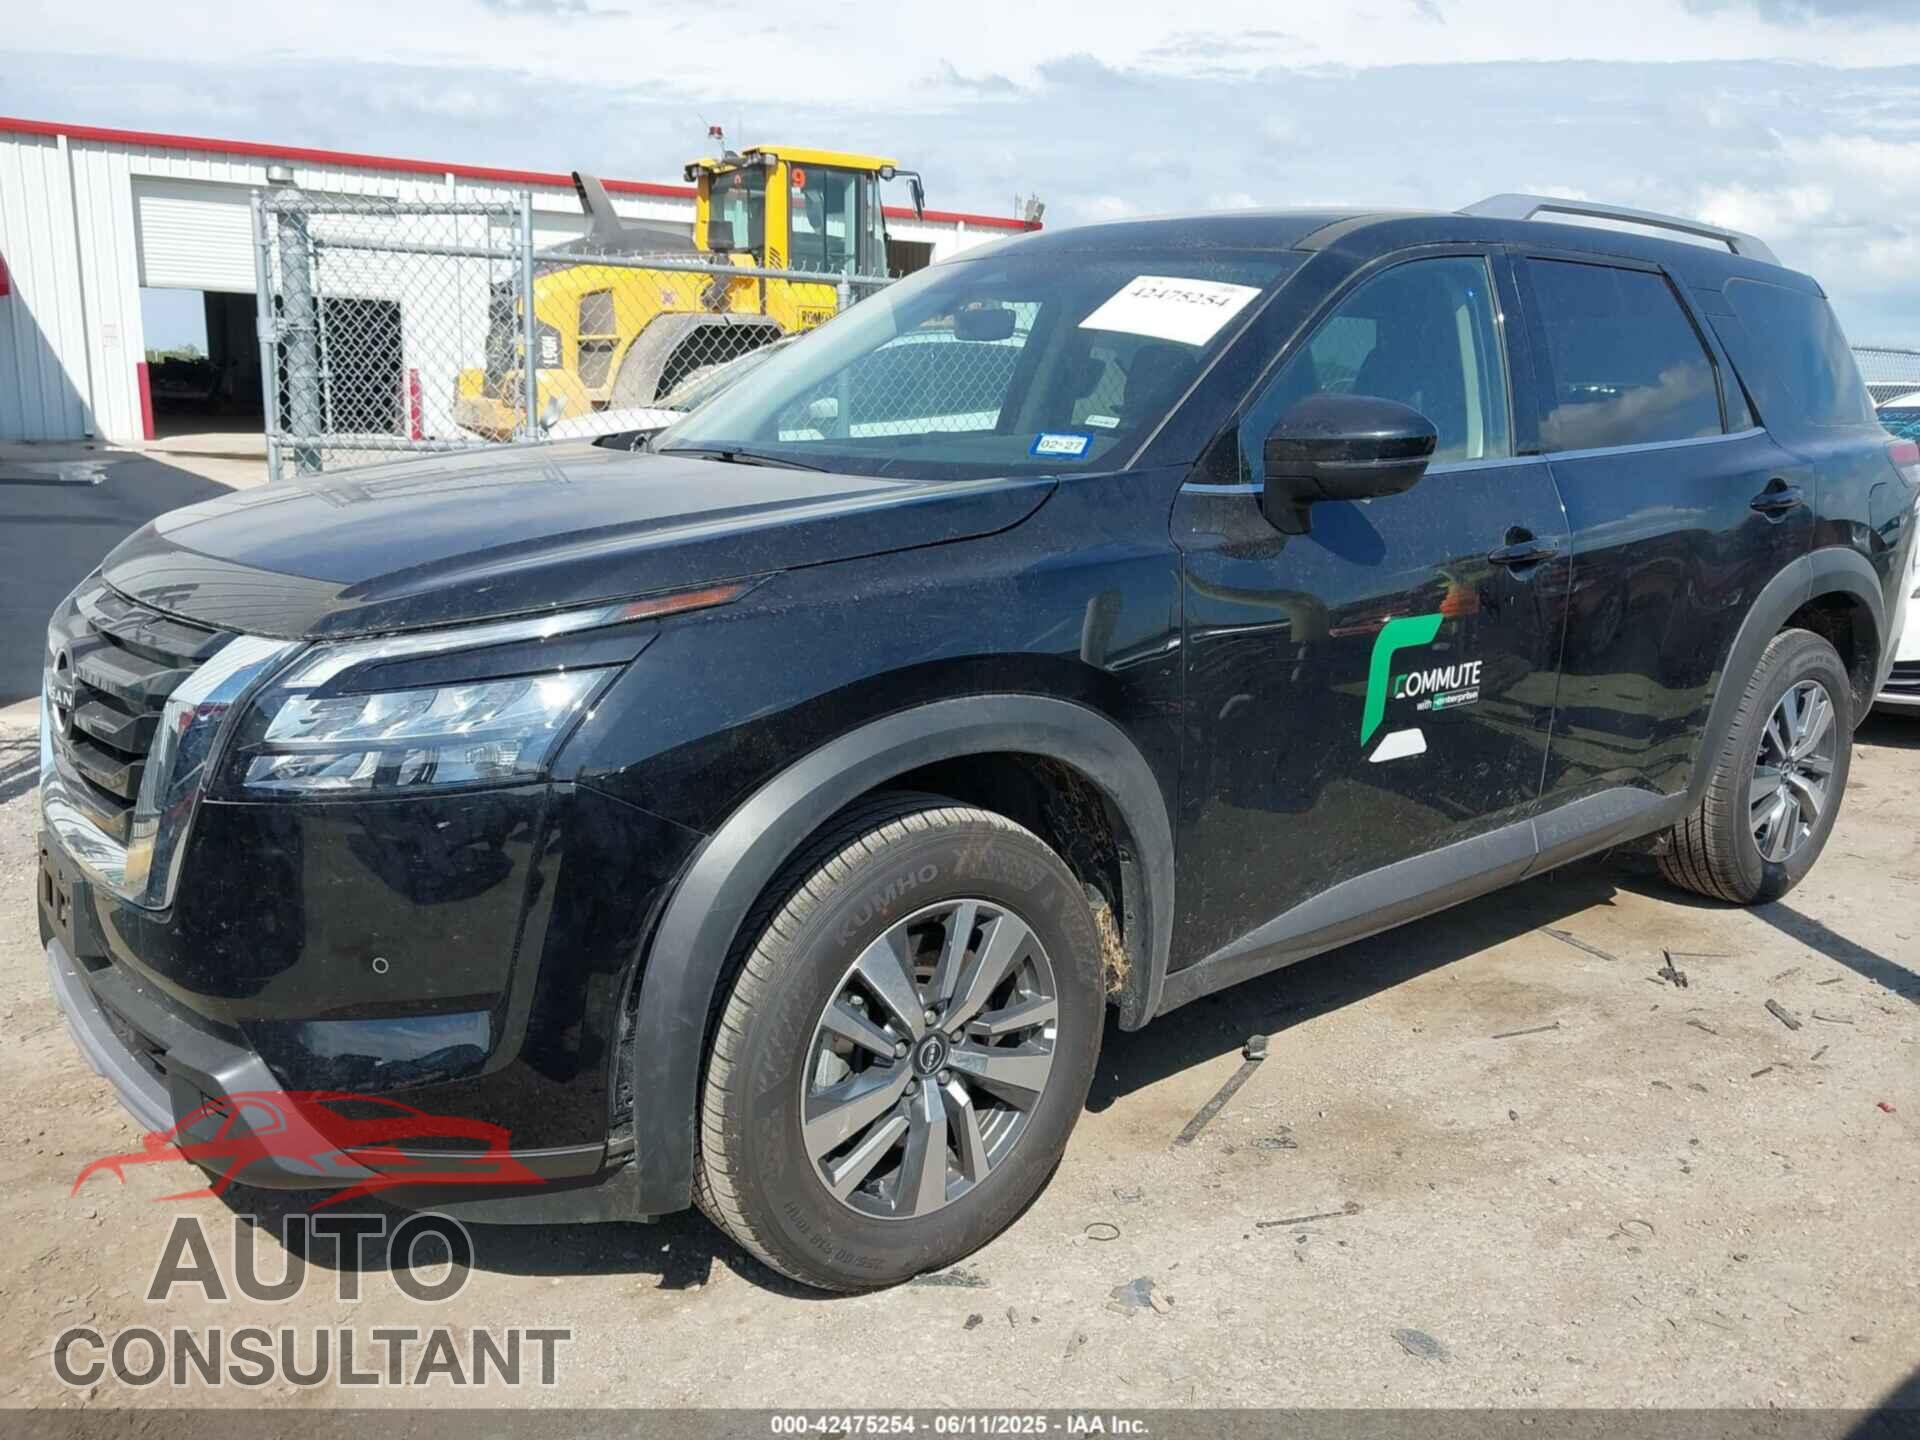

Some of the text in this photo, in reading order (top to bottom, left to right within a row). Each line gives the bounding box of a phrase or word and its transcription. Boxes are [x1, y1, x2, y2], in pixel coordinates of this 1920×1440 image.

[791, 168, 805, 189] 9
[1130, 288, 1231, 307] 42475254
[1393, 660, 1482, 700] COMMUTE
[1416, 699, 1432, 711] with
[836, 864, 939, 945] KUMHO
